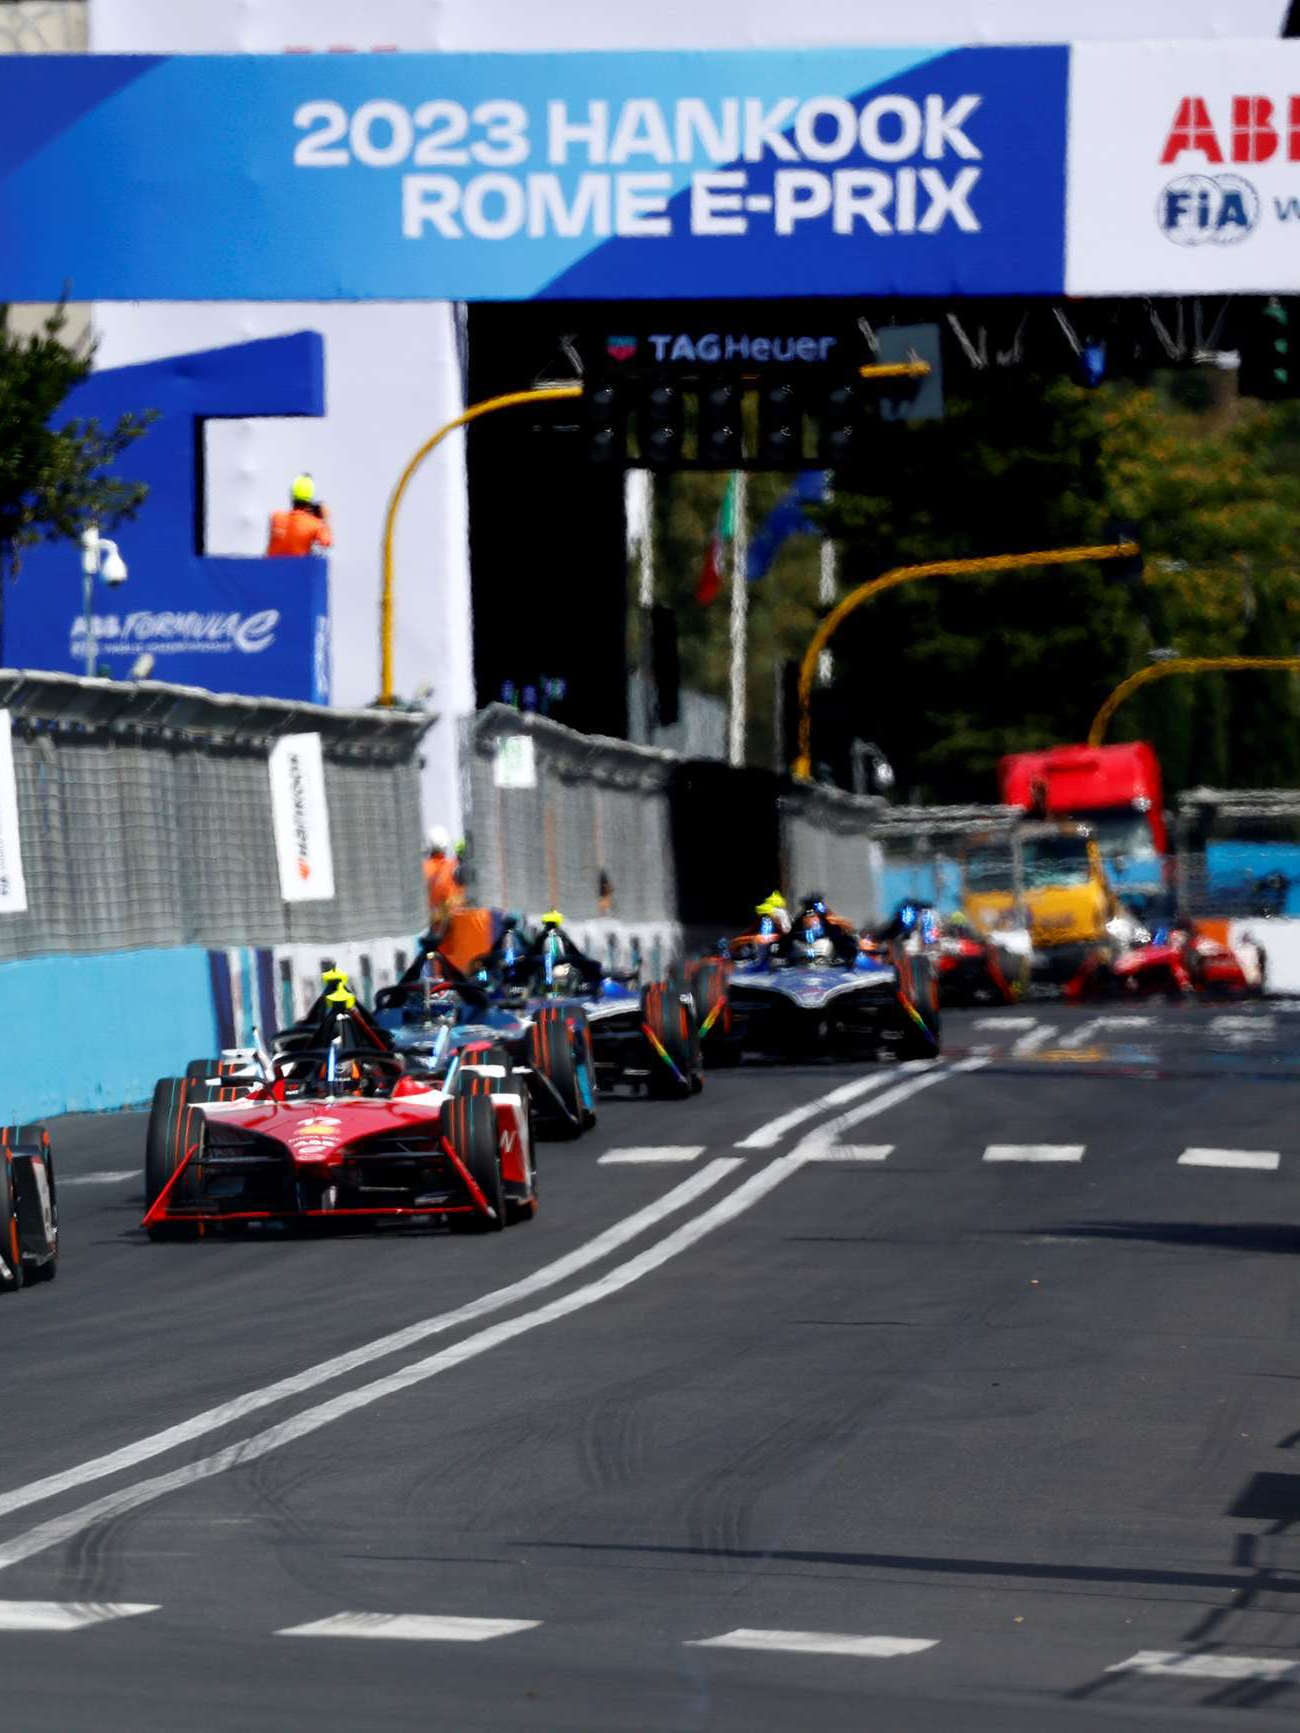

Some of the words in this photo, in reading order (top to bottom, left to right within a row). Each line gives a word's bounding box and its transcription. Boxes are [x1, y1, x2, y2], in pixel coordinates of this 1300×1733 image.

[292, 100, 530, 168] 2023
[548, 94, 984, 165] HANKOOK
[1158, 94, 1300, 165] AB
[401, 171, 672, 239] ROME
[690, 167, 982, 236] E-PRIX
